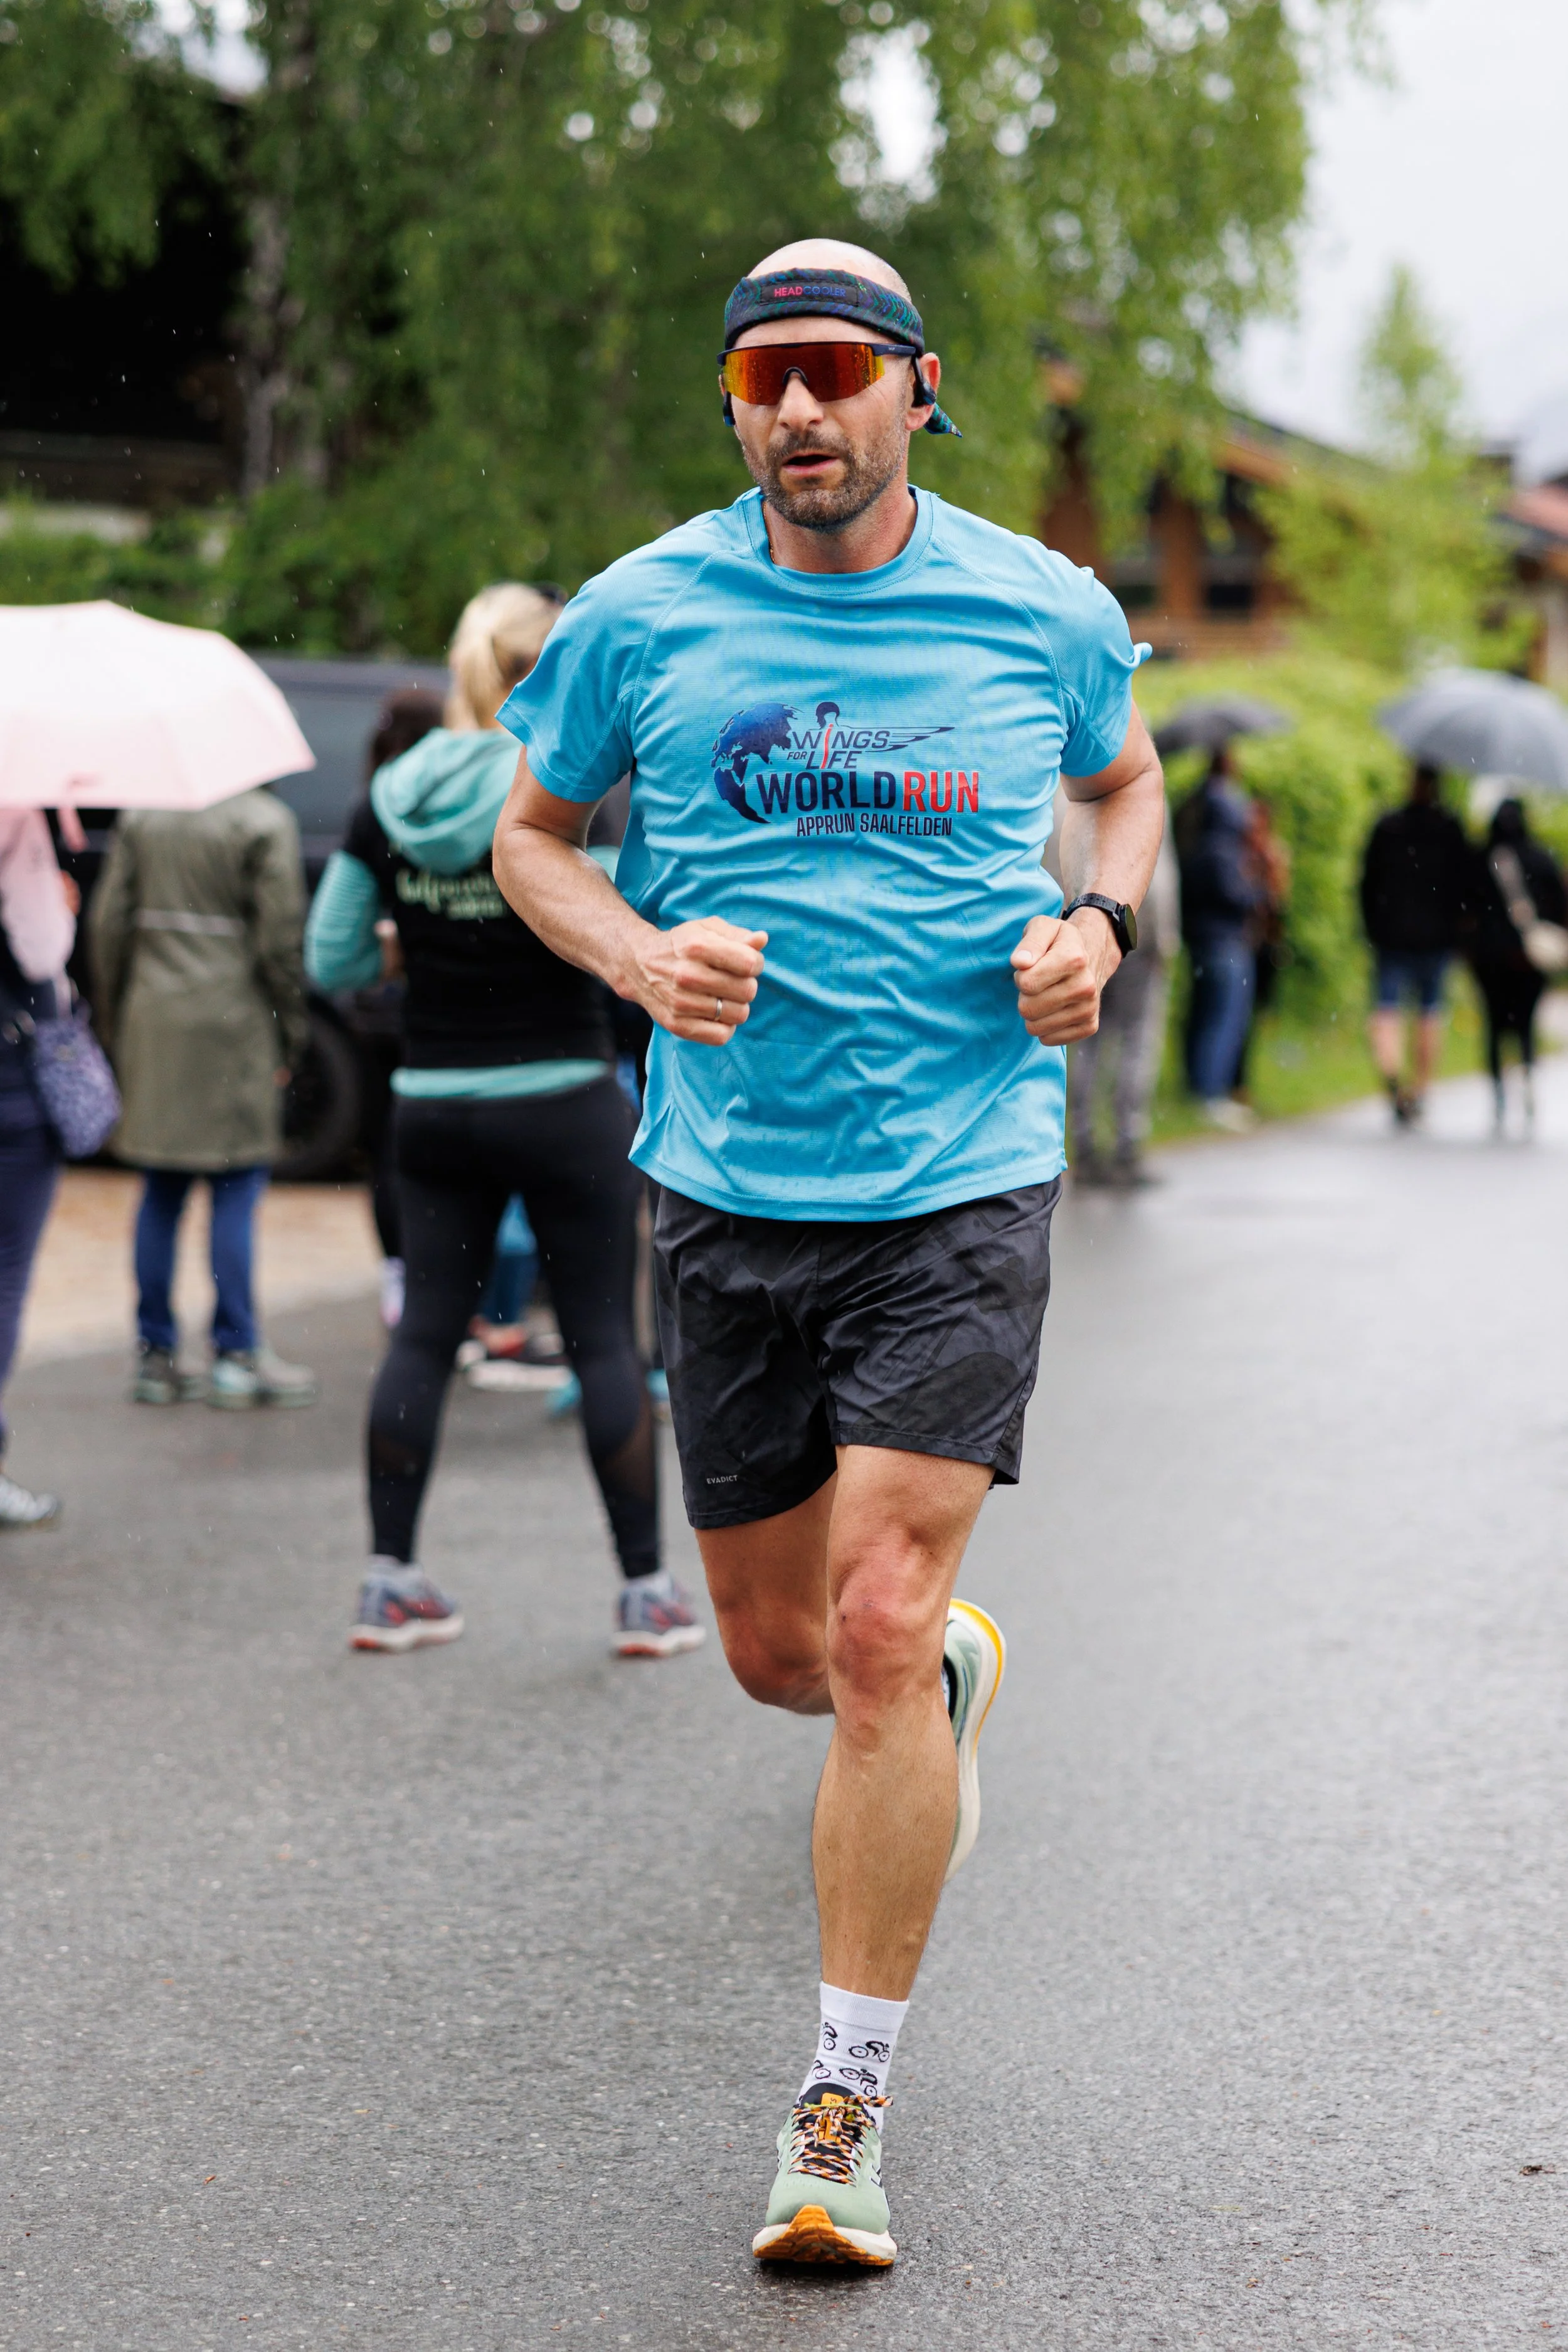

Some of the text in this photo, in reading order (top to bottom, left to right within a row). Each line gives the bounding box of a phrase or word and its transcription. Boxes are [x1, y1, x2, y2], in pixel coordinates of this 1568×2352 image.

[774, 285, 846, 297] HEADCOOLER
[792, 729, 890, 750] WINGS
[787, 750, 860, 769] FOR LIFE
[756, 771, 979, 814] WORLD RUN
[796, 813, 953, 837] APPRUN SAALFELDEN
[706, 1475, 738, 1485] EVADICT
